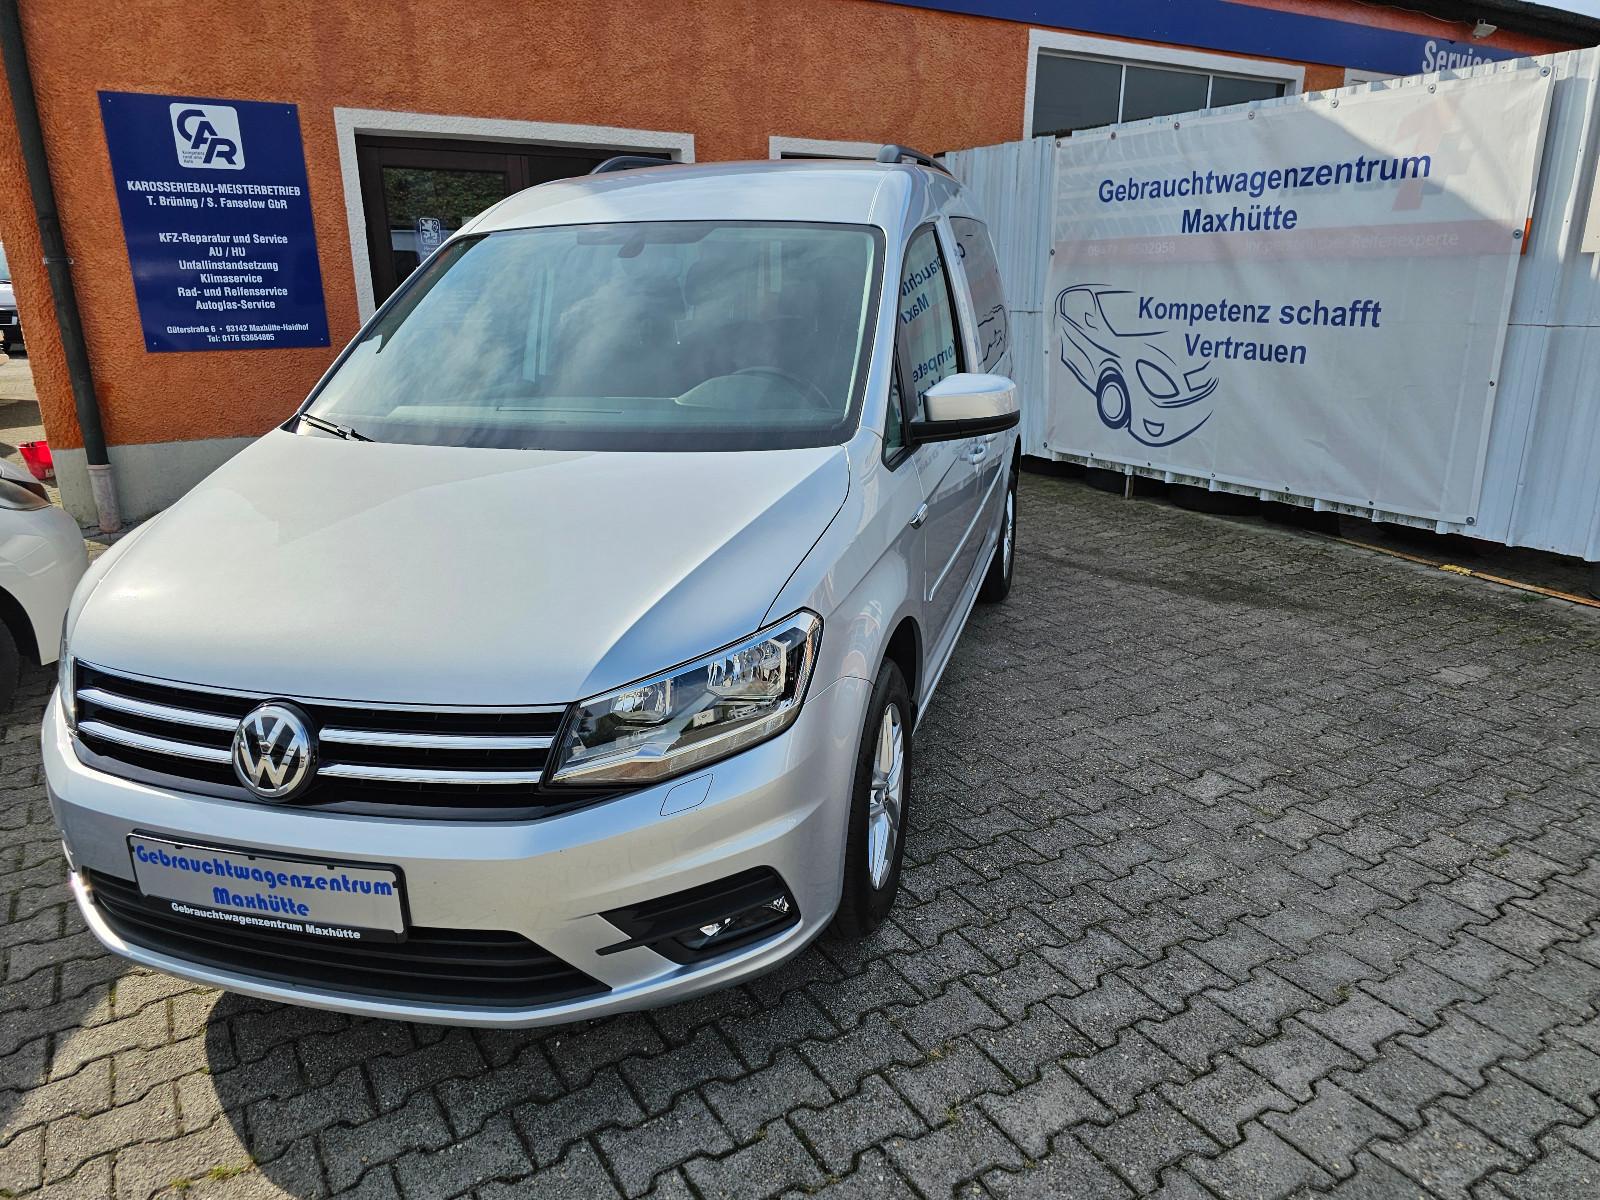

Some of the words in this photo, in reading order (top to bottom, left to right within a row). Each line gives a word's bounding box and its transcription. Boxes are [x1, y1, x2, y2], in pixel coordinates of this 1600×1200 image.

[177, 109, 237, 165] CAR
[1099, 154, 1432, 203] Gebrauchtwagenzentrum
[127, 180, 301, 196] KAROSSERIEBAU-MEISTERBETRIEB
[146, 195, 157, 206] T.
[159, 197, 198, 209] Brüning
[207, 199, 218, 207] S.
[220, 198, 265, 209] Fanselow
[267, 199, 288, 209] GbR
[1181, 205, 1299, 234] Maxhütte
[159, 232, 231, 244] KFZ-Reparatur
[232, 234, 251, 244] und
[252, 234, 288, 244] Service
[208, 246, 223, 257] AU
[231, 246, 246, 257] HU
[178, 260, 279, 272] Unfallinstandsetzung
[200, 273, 263, 283] Klimaservice
[177, 287, 202, 297] Rad-
[203, 288, 222, 297] und
[224, 287, 288, 297] Reifenservice
[195, 300, 276, 311] Autoglas-Service
[1138, 297, 1270, 325] Kompetenz
[1279, 300, 1382, 328] schafft
[166, 325, 209, 334] Güterstraße
[249, 323, 309, 332] Maxhütte-Haidhof
[207, 335, 221, 343] Tel:
[1184, 333, 1307, 364] Vertrauen
[136, 845, 392, 896] Gebrauchtwagenzentrum
[213, 887, 310, 916] Maxhütte
[171, 902, 303, 932] Gebrauchtwagenzentrum
[305, 924, 361, 939] Maxhütte
